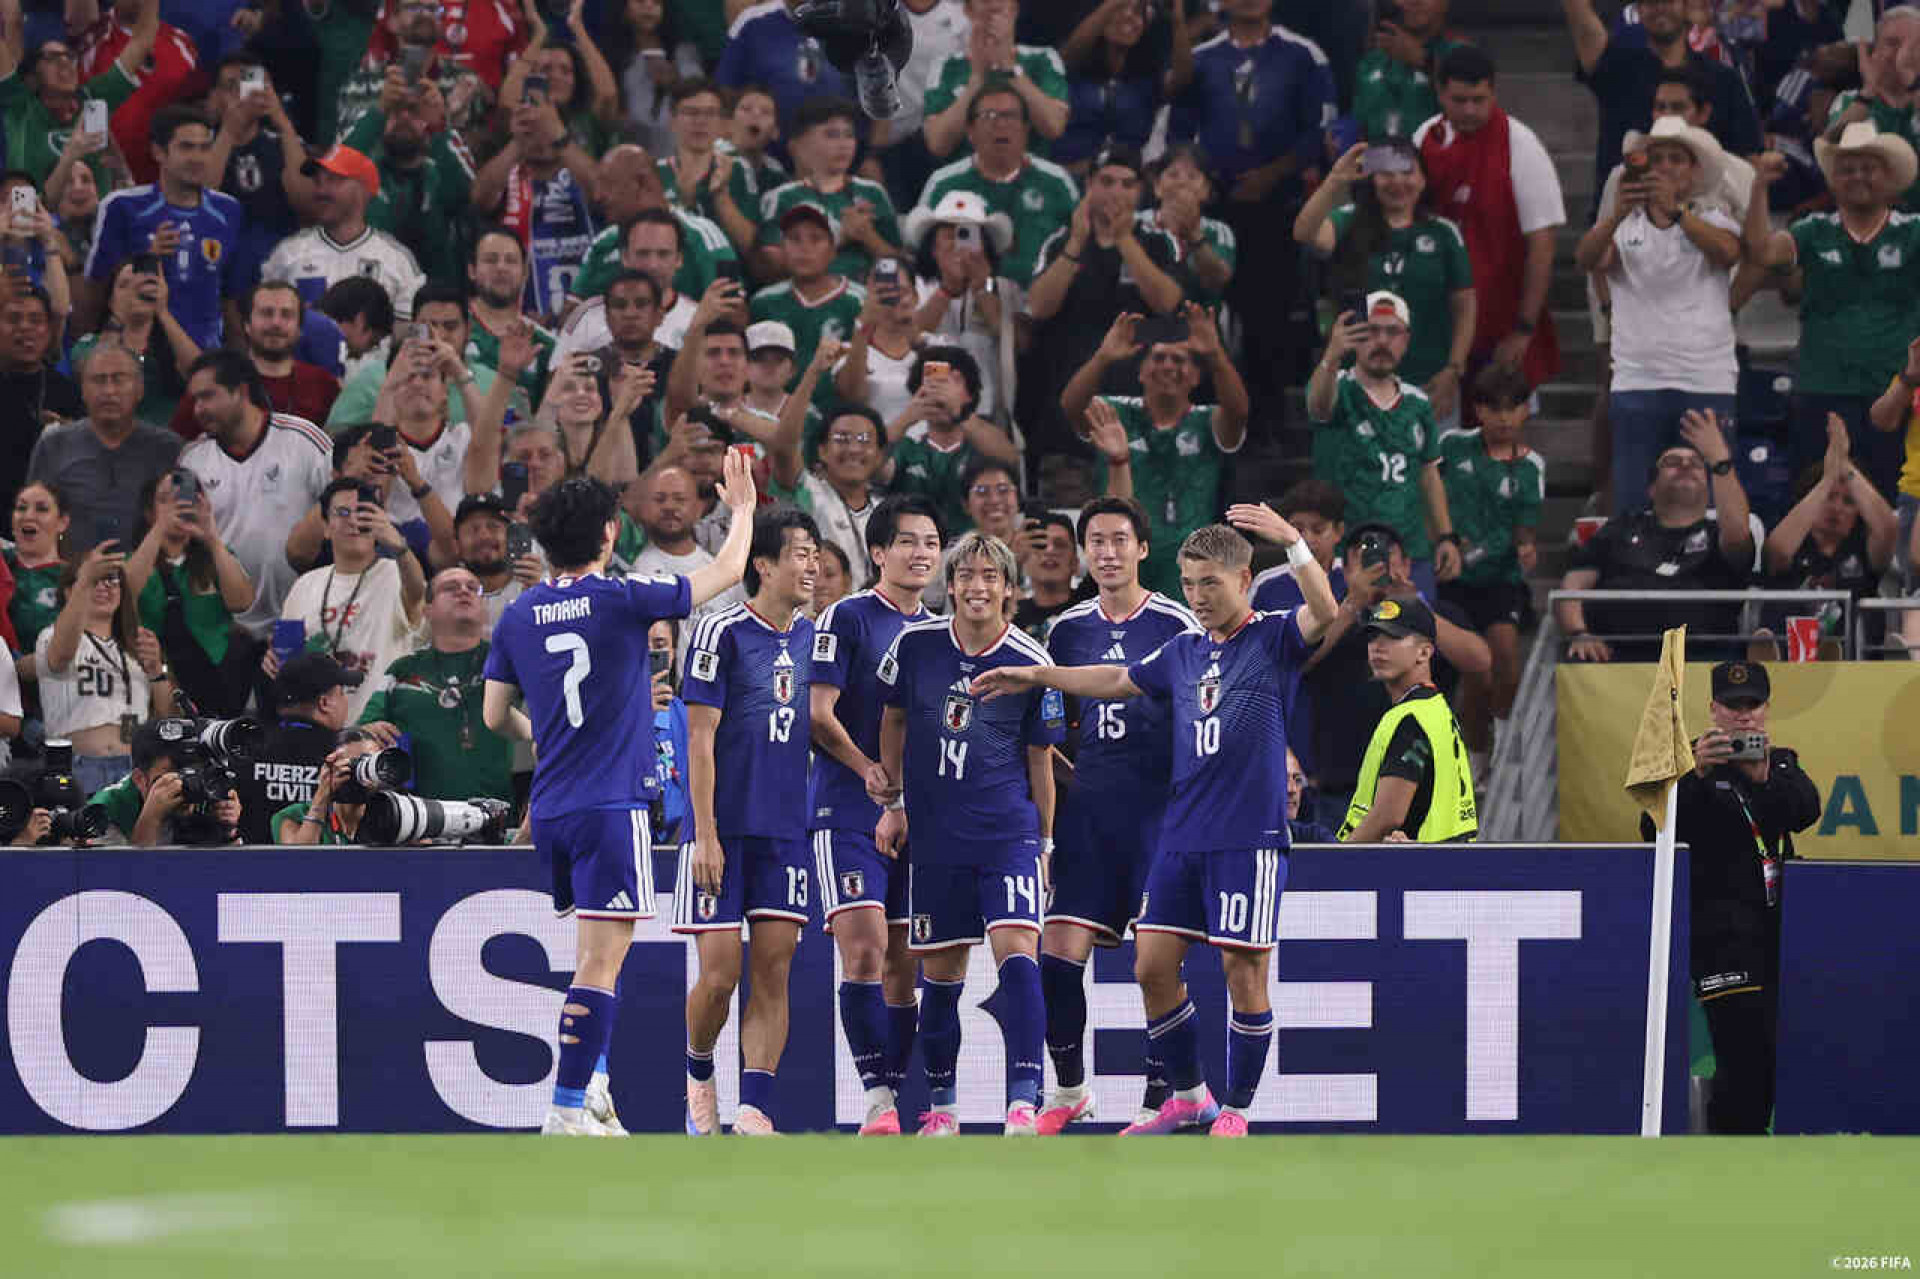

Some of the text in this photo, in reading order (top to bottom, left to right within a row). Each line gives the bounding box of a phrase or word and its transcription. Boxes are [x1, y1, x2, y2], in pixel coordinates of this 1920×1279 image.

[1379, 452, 1407, 483] 12
[532, 597, 592, 625] TANAKA
[77, 665, 114, 697] 20
[545, 632, 592, 729] 7
[768, 707, 796, 743] 13
[1097, 703, 1127, 740] 15
[1193, 716, 1221, 757] 10
[254, 762, 319, 784] FUERZ
[938, 737, 971, 781] 14
[266, 783, 313, 802] CIVIL
[786, 866, 808, 908] 13
[1003, 874, 1038, 914] 14
[1219, 891, 1248, 932] 10
